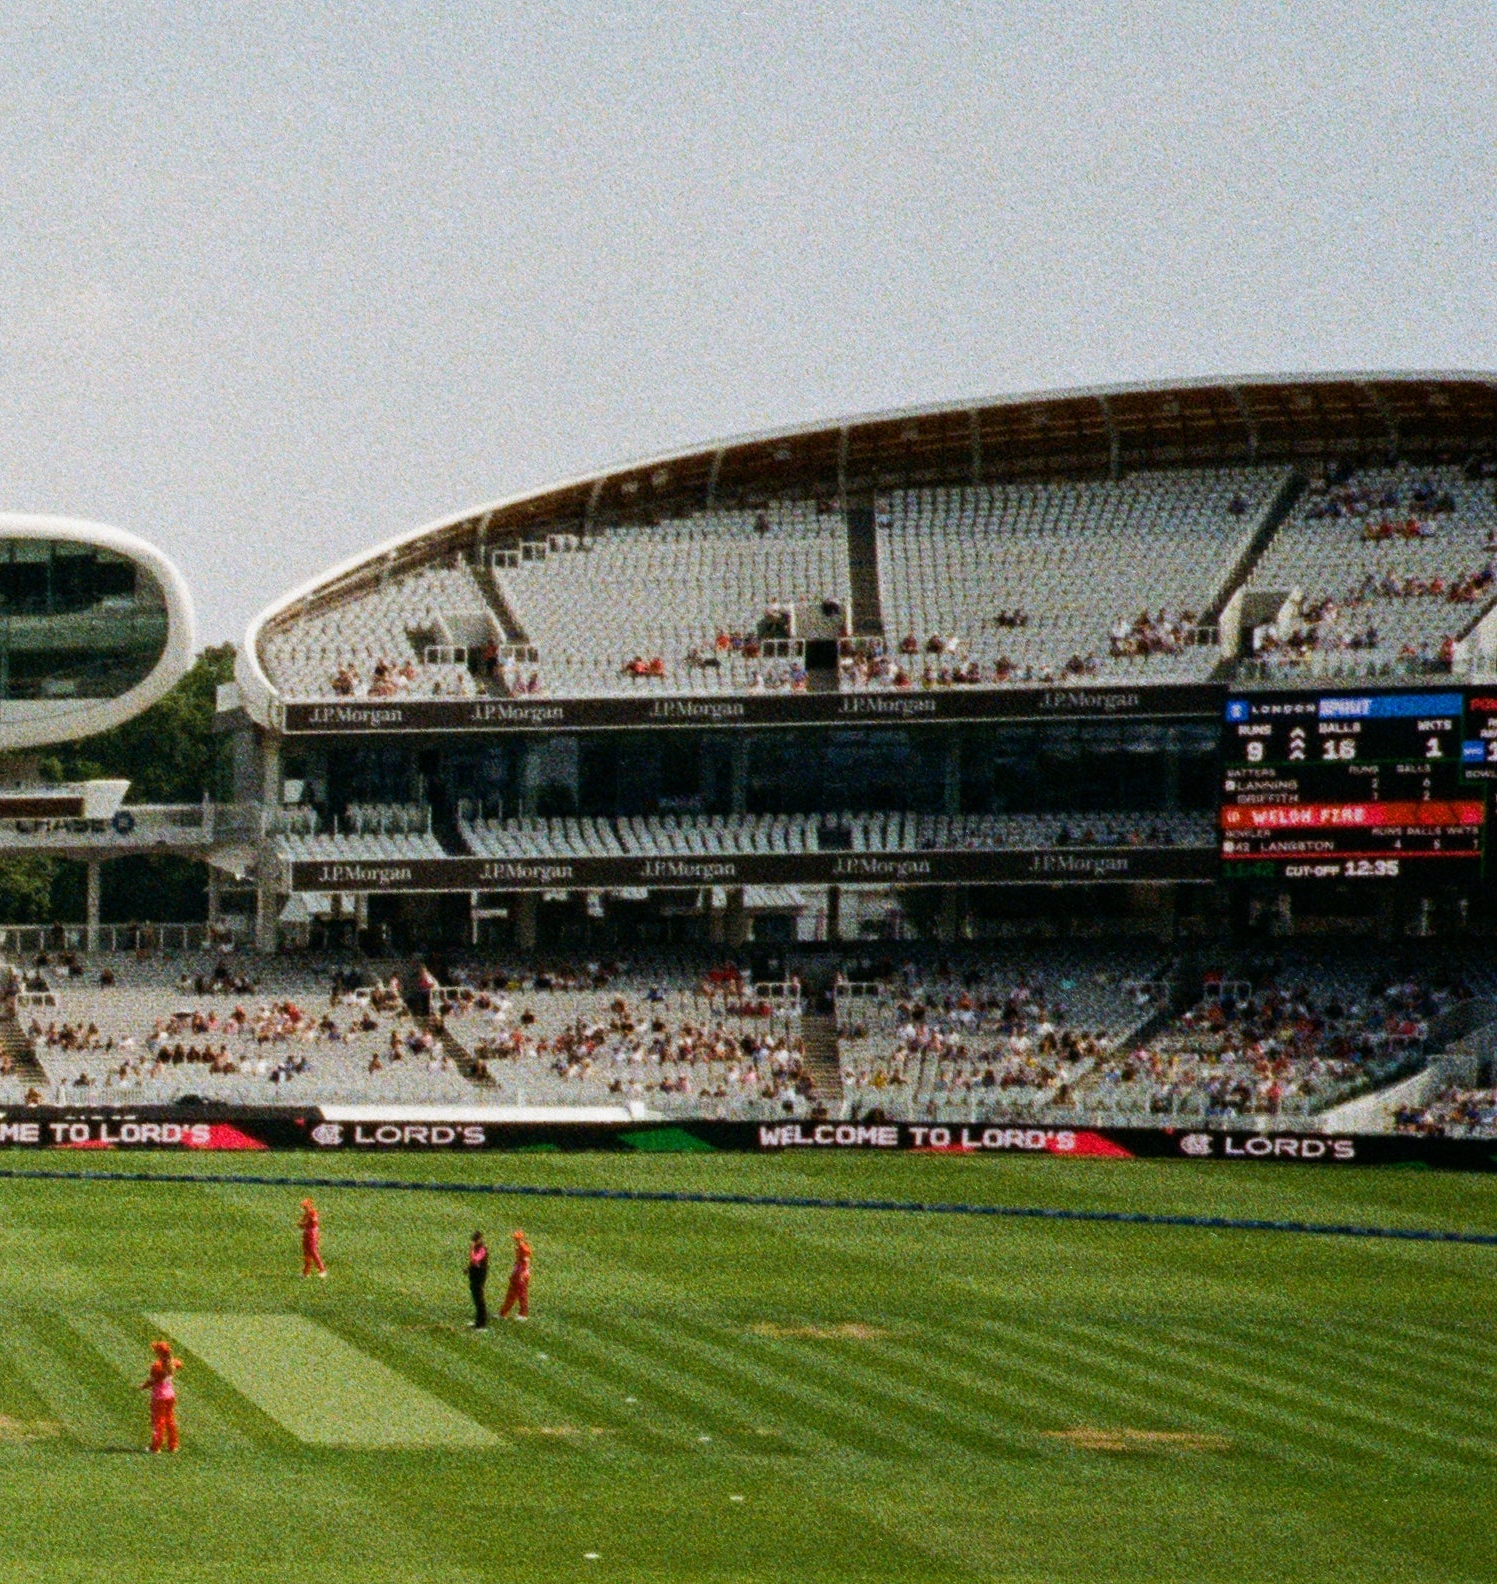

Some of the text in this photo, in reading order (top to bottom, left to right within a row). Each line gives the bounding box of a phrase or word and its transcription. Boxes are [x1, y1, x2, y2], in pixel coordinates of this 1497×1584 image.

[309, 705, 402, 728] J.P.Morgan
[470, 703, 563, 725] J.P.Morgan
[1251, 704, 1316, 715] LONDON
[1238, 719, 1452, 736] RUNS BALLS WKTS
[1322, 739, 1356, 761] 16
[1425, 737, 1443, 758] 1
[1251, 808, 1366, 824] WELSH FIRE
[319, 863, 412, 887] J.P.Morgan
[480, 861, 573, 883] J.P.Morgan
[1285, 864, 1341, 877] CUT-OFF
[1345, 860, 1399, 876] 12:35
[50, 1123, 89, 1143] TO
[100, 1123, 211, 1144] LORD'S
[354, 1125, 486, 1145] LORD'S
[760, 1124, 1077, 1150] WELCOME TO LORD'S
[1226, 1136, 1356, 1159] LORD'S
